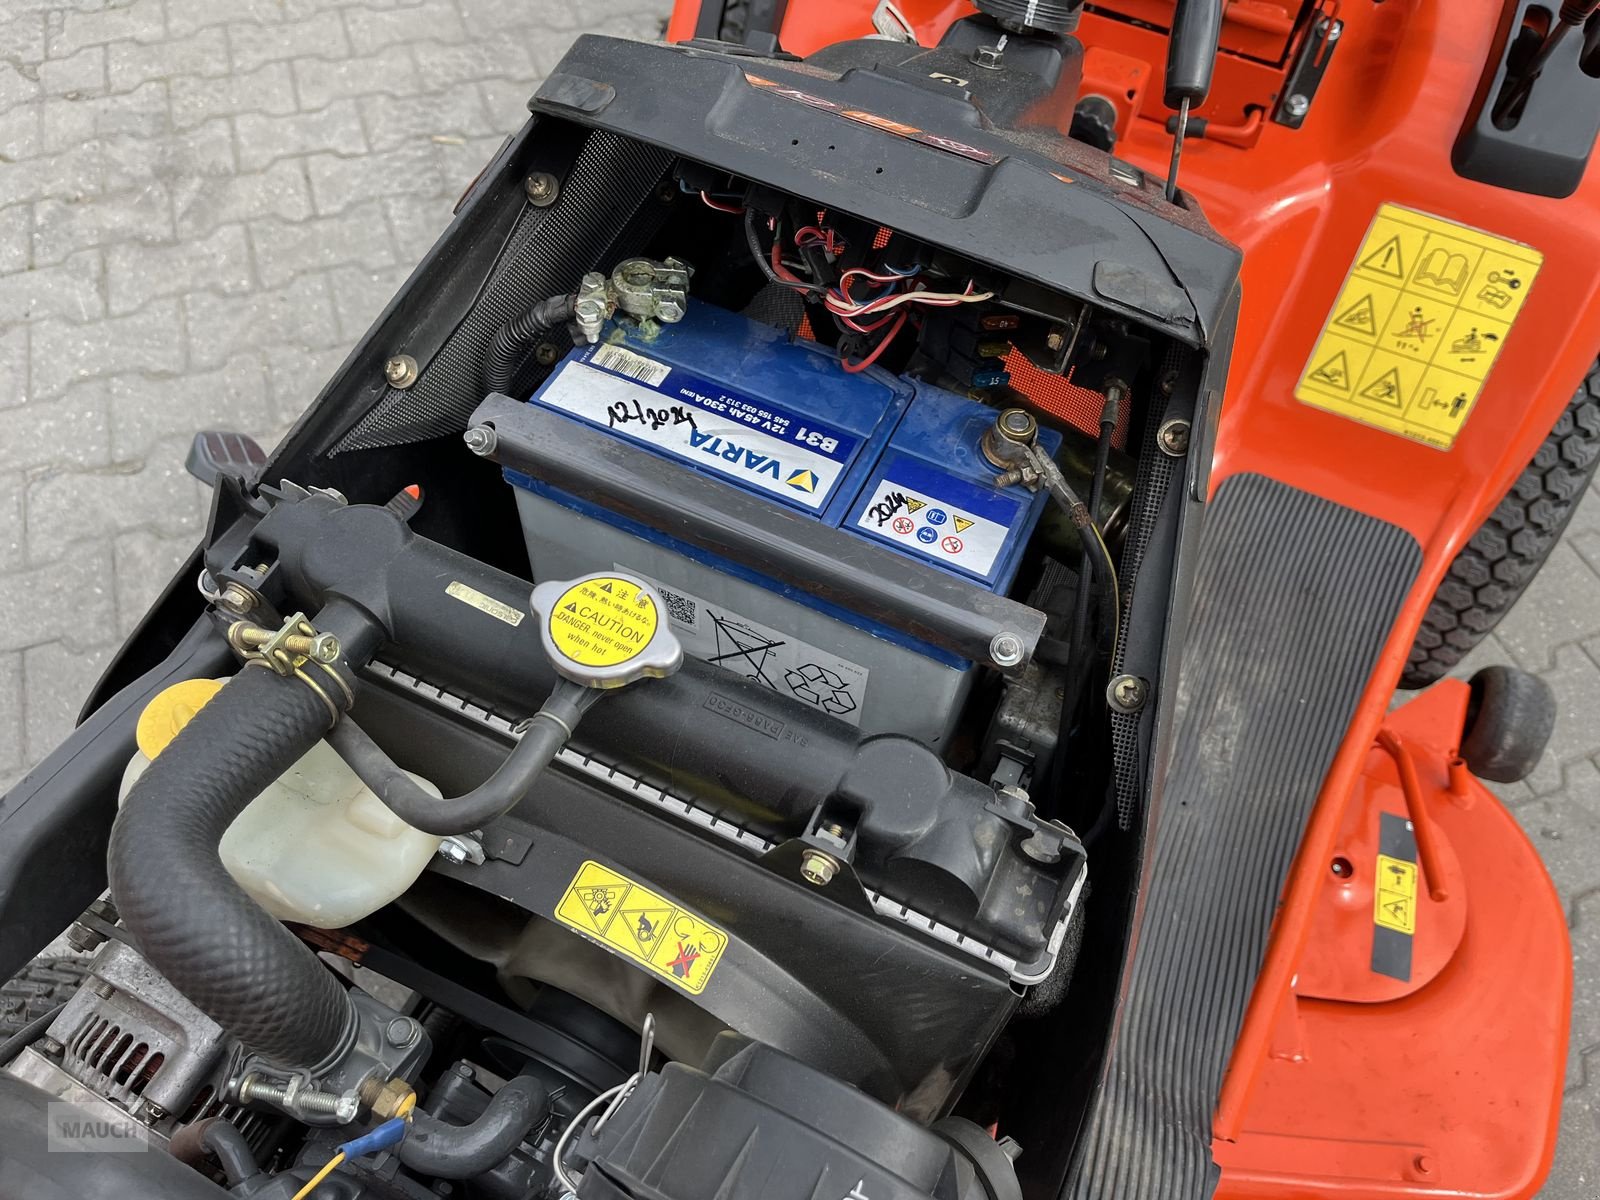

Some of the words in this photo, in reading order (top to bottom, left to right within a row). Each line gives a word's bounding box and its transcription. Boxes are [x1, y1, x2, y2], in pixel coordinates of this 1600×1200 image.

[725, 398, 741, 408] 313
[741, 403, 757, 414] 033
[757, 409, 774, 420] 155
[773, 415, 790, 426] 545
[761, 422, 786, 435] 12V
[795, 427, 839, 453] B31
[688, 428, 781, 480] VARTA
[579, 606, 645, 643] CAUTION
[567, 632, 590, 648] when
[591, 642, 606, 656] hot
[592, 630, 614, 645] never
[614, 640, 633, 654] open
